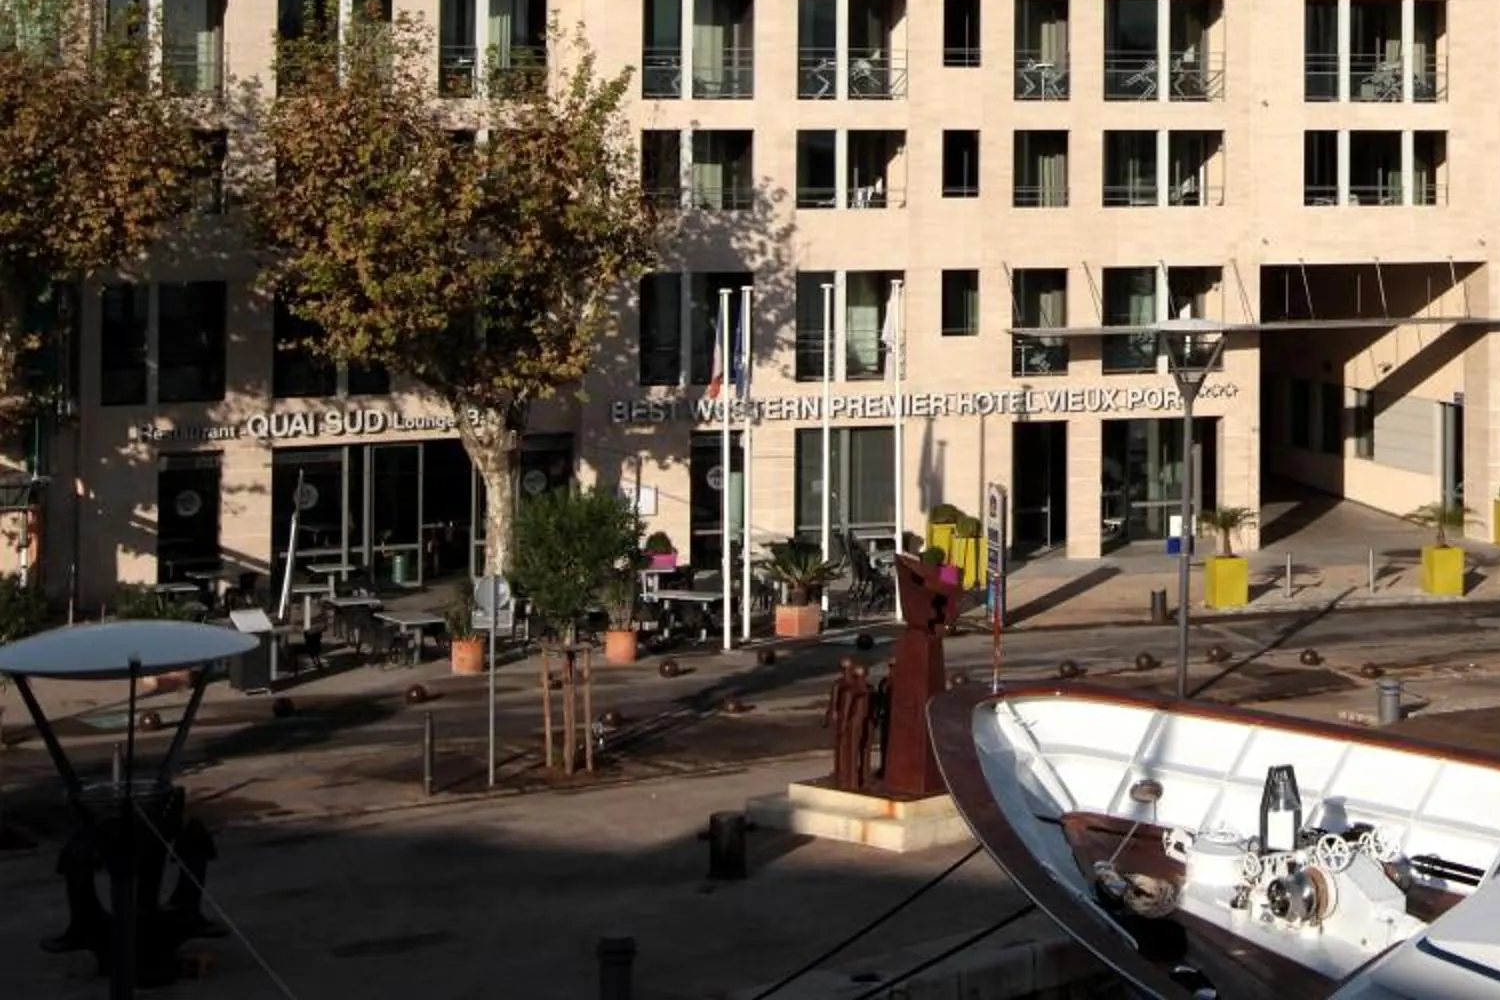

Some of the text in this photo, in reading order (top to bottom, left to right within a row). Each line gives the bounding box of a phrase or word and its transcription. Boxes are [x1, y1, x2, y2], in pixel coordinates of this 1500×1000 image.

[611, 401, 680, 423] BEST
[829, 393, 950, 418] PREMIER
[957, 391, 1041, 415] HOTEL
[1046, 388, 1120, 412] VIEUX
[1126, 386, 1192, 411] POR
[248, 412, 316, 437] QUAI
[325, 410, 384, 436] SUD
[394, 412, 455, 430] Lounge
